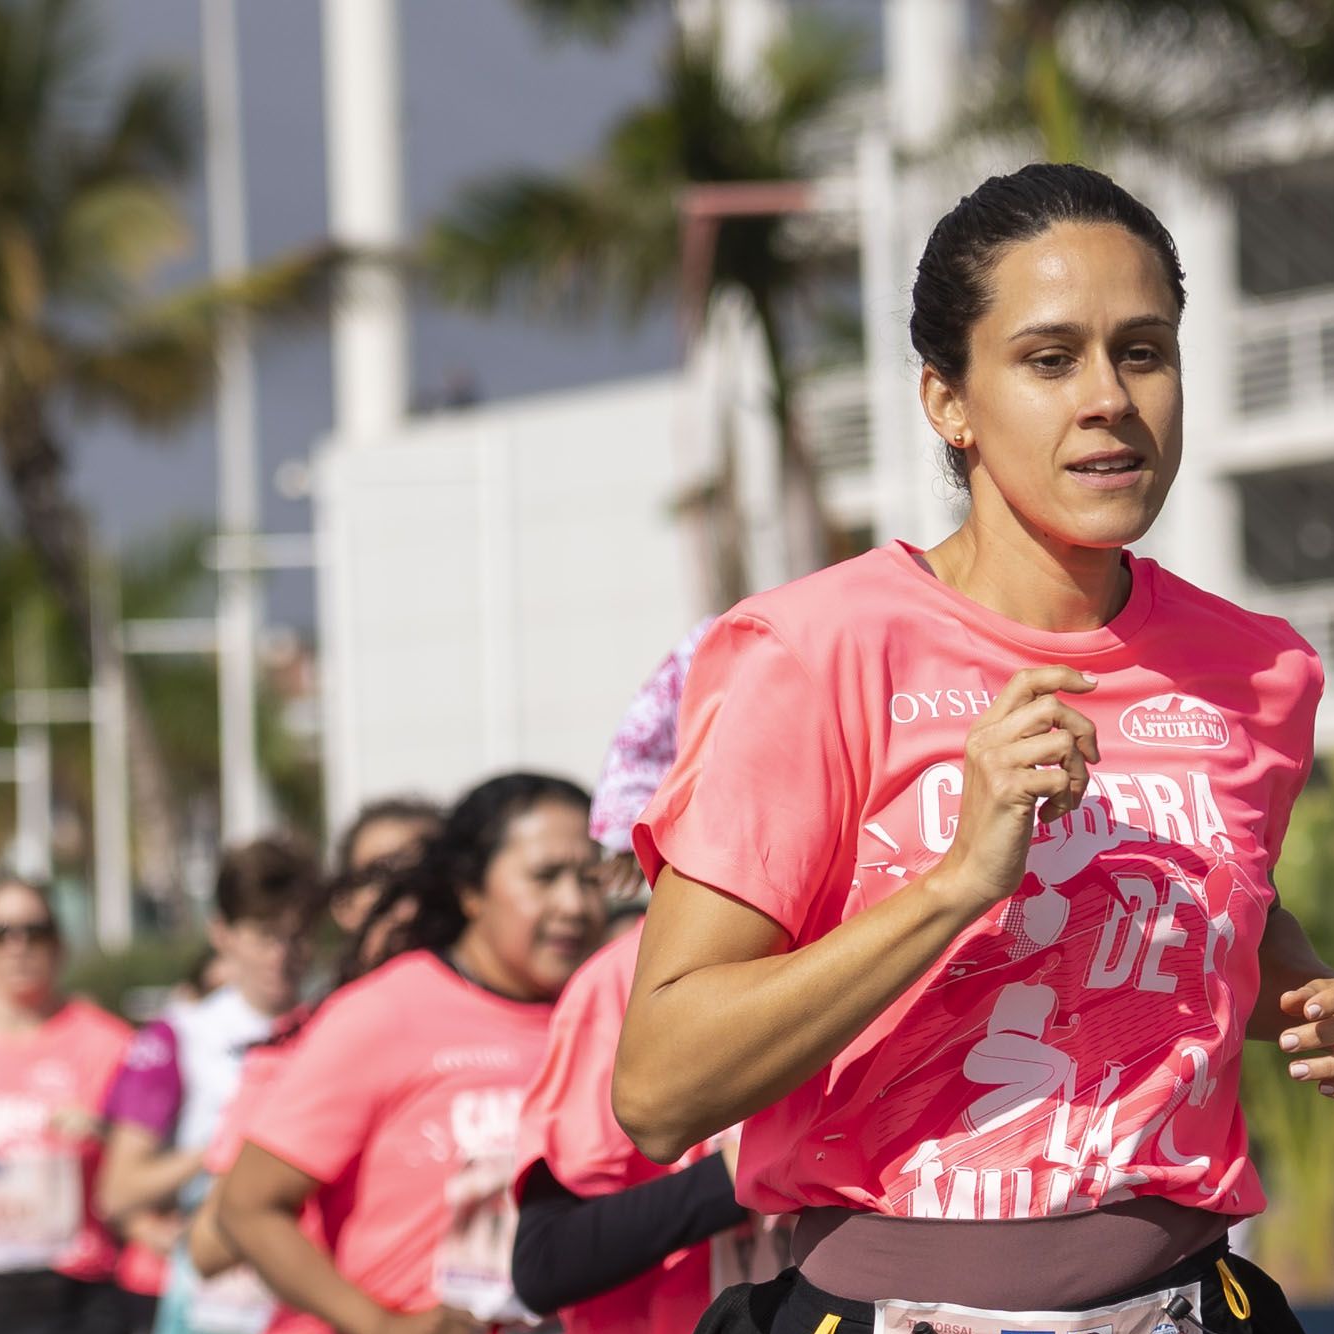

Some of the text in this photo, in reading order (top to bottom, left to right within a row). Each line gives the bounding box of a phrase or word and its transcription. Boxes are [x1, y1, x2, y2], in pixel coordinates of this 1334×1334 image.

[890, 690, 998, 723] OYSH
[1131, 714, 1225, 742] ASTURIANA
[1082, 872, 1209, 994] DE
